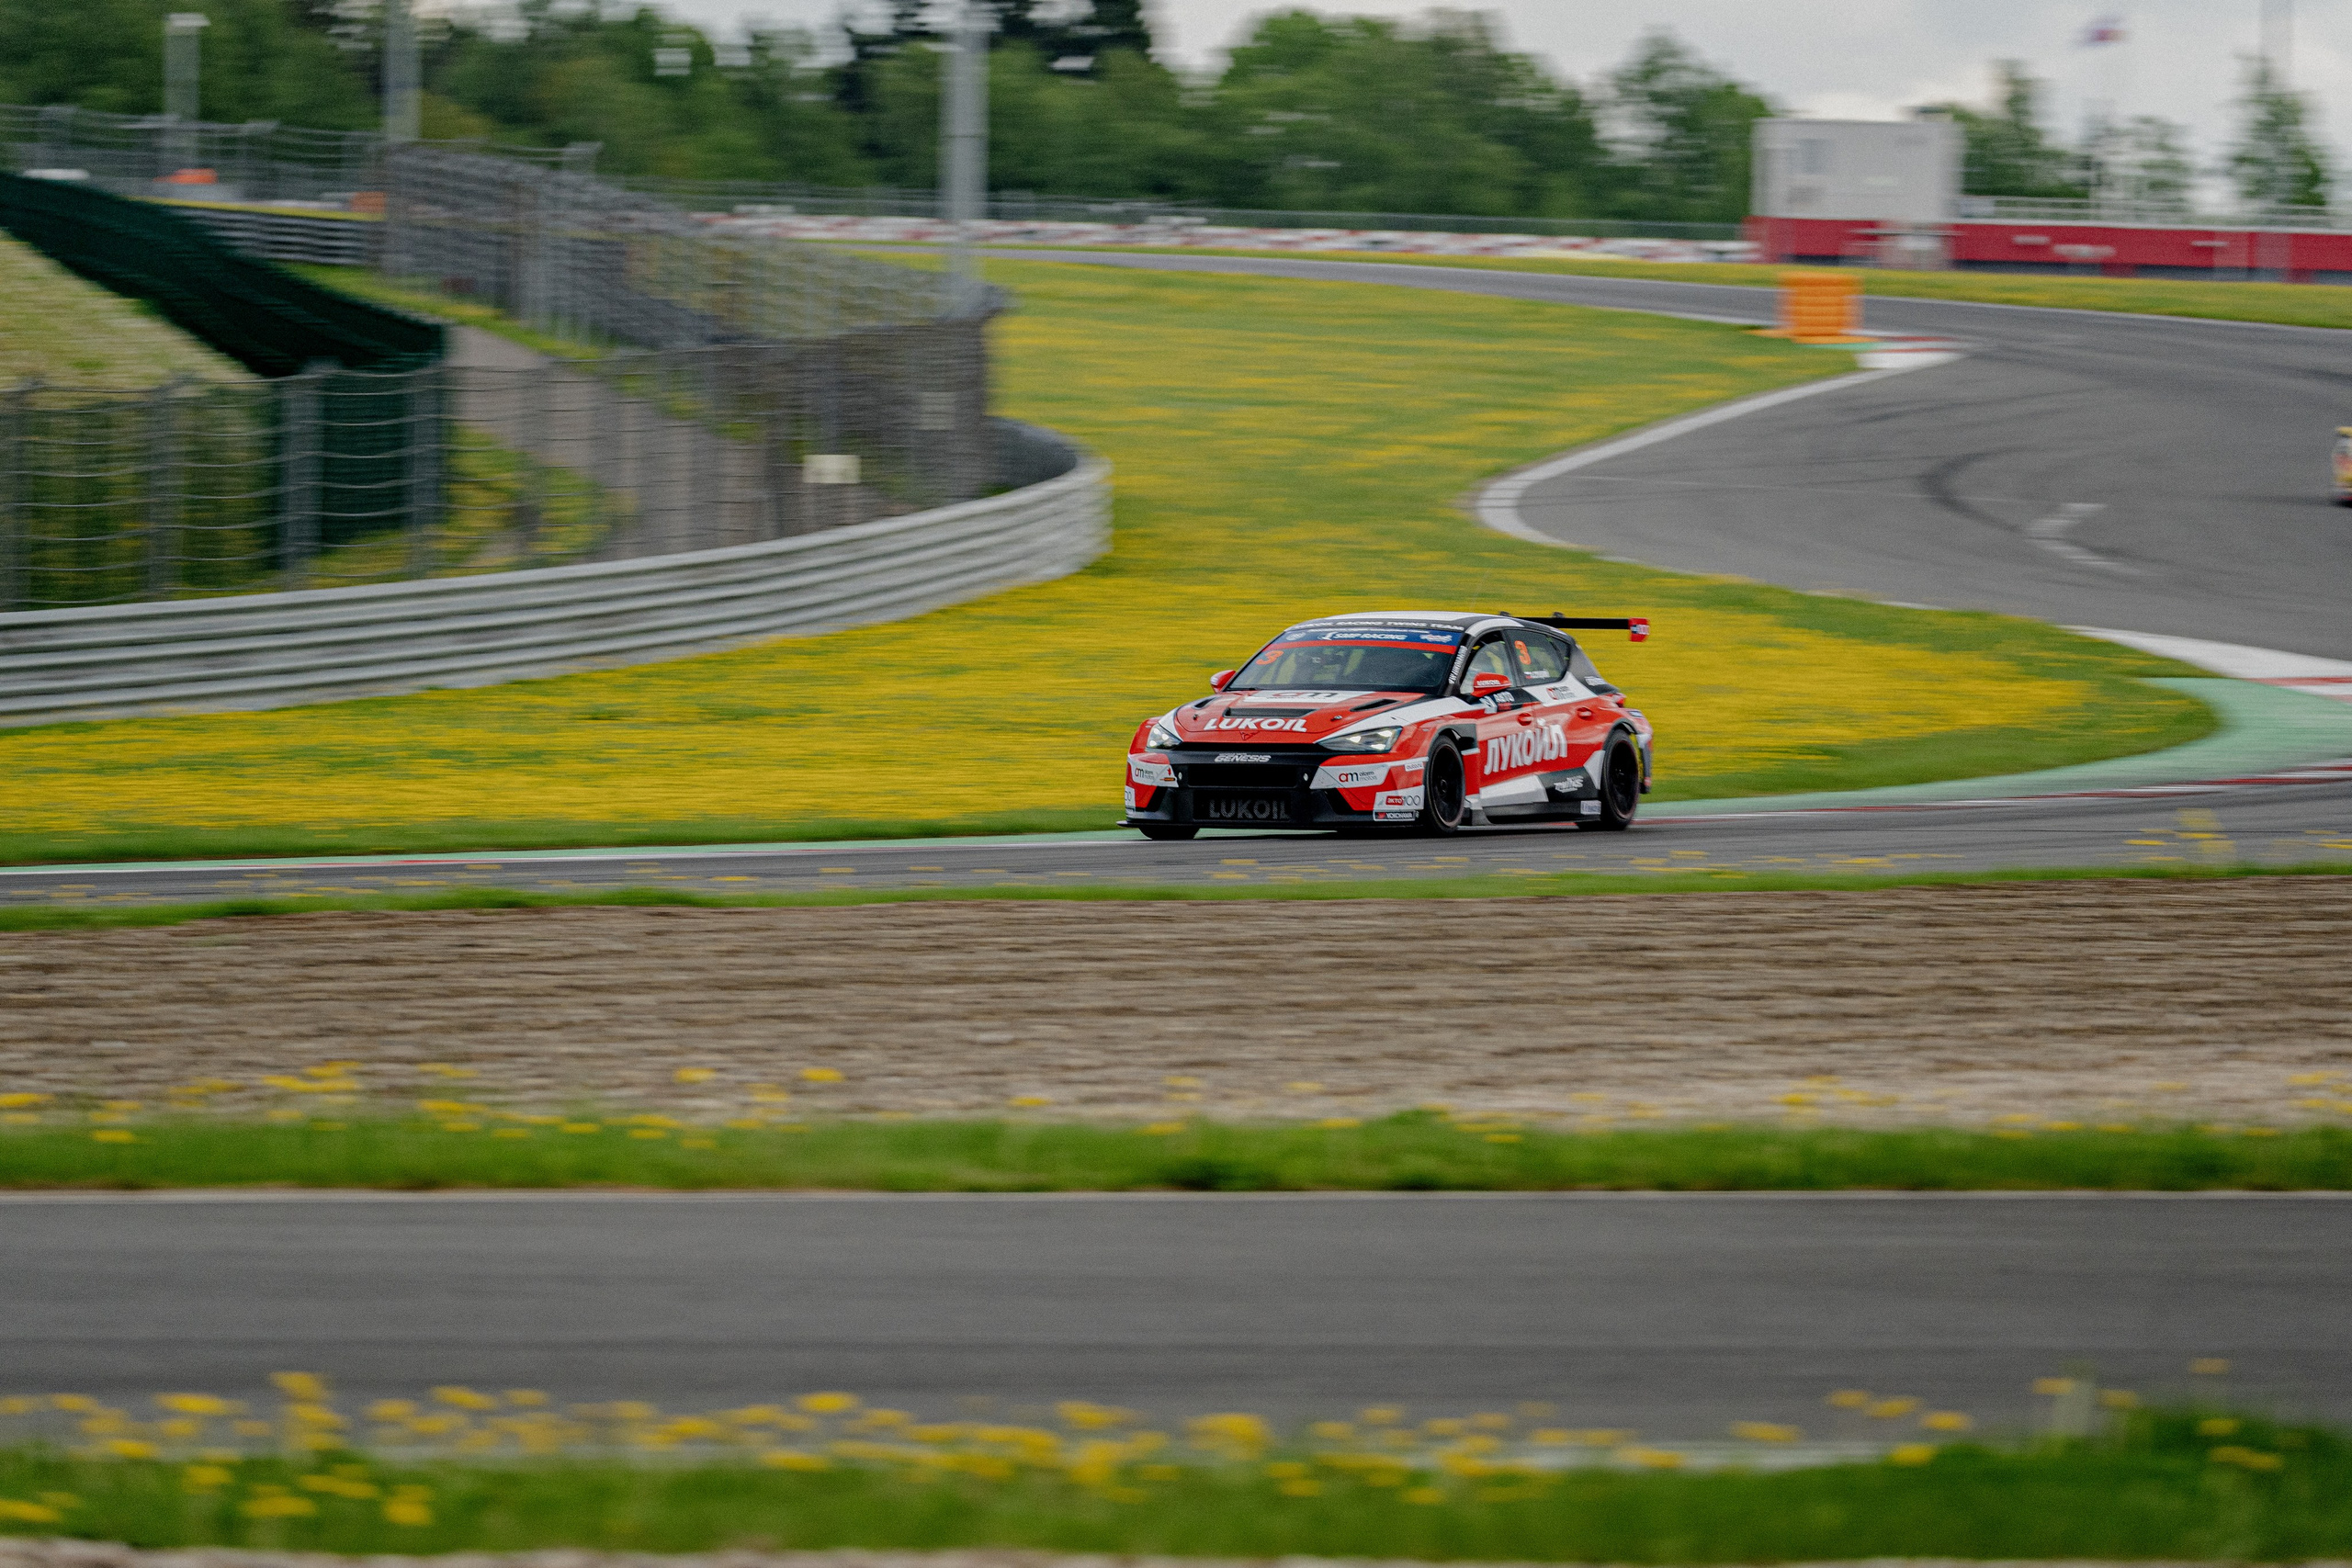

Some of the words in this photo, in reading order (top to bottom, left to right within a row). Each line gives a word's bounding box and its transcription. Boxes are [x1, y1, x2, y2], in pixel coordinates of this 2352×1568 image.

[1255, 650, 1284, 665] 3
[1514, 640, 1532, 665] 3
[1204, 717, 1307, 732] LUKOIL
[1484, 718, 1568, 775] ЛУКОЙЛ
[1214, 754, 1272, 763] GENESIS
[1339, 773, 1359, 782] am
[1209, 799, 1291, 819] LUKOIL
